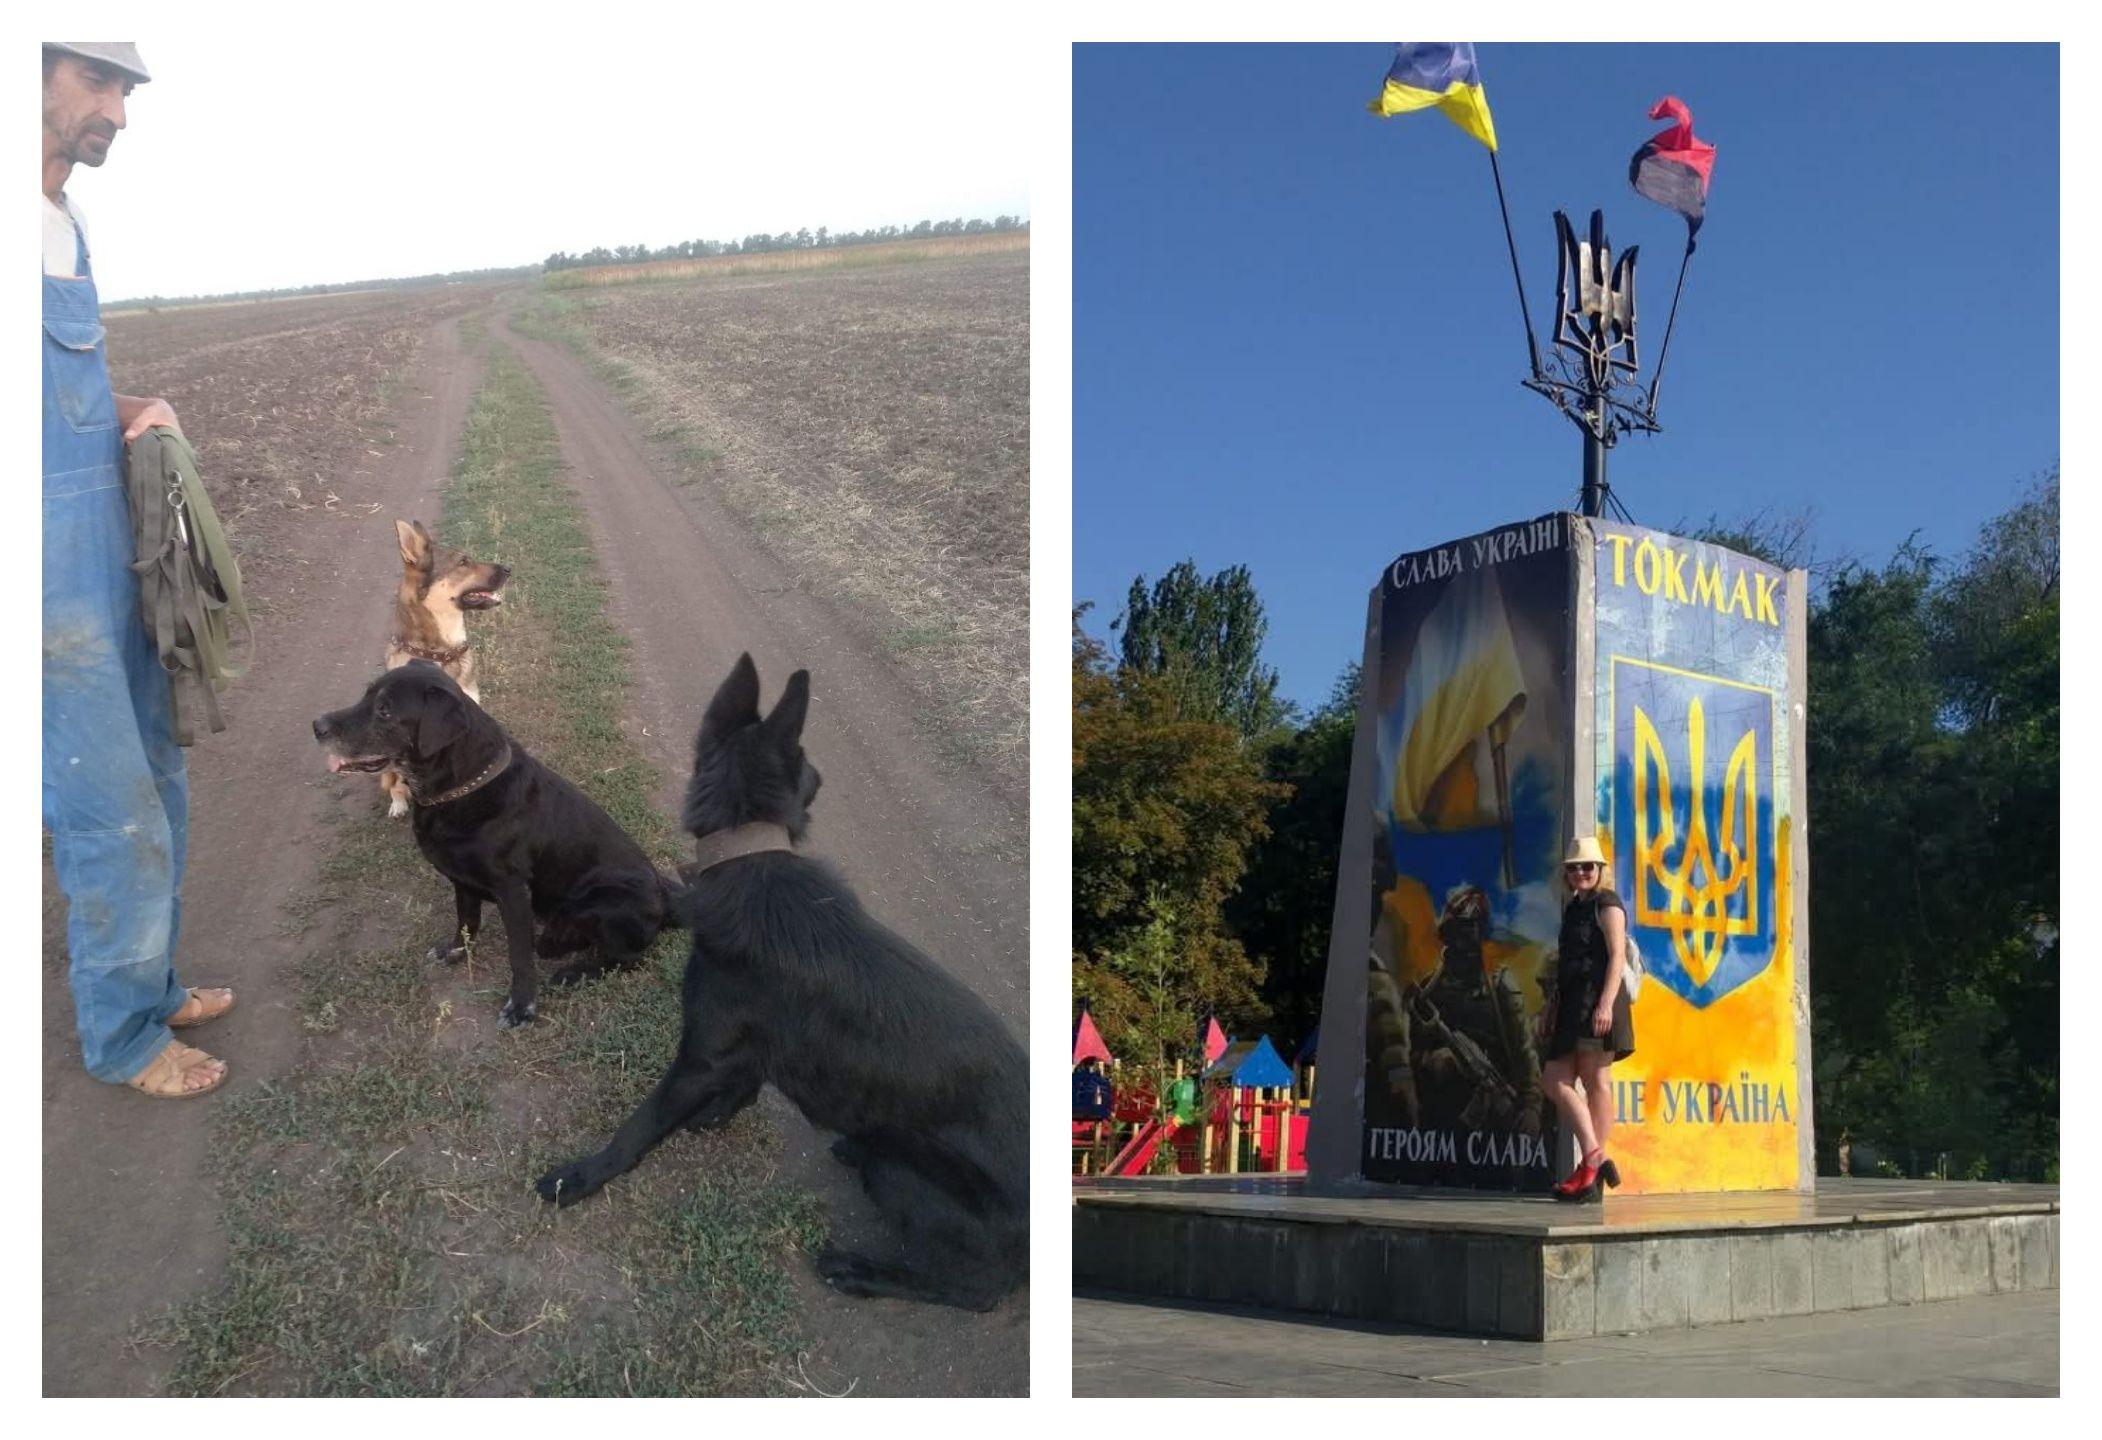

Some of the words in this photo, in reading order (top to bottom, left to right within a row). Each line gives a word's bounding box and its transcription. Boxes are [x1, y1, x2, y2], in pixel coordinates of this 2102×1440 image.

[1392, 546, 1463, 588] СЛАВА
[1605, 534, 1779, 627] ТОКМАК
[1660, 1071, 1791, 1124] УКРАЇНА
[1370, 1126, 1457, 1163] ГЕРОЯМ
[1467, 1131, 1548, 1168] СЛАВА
